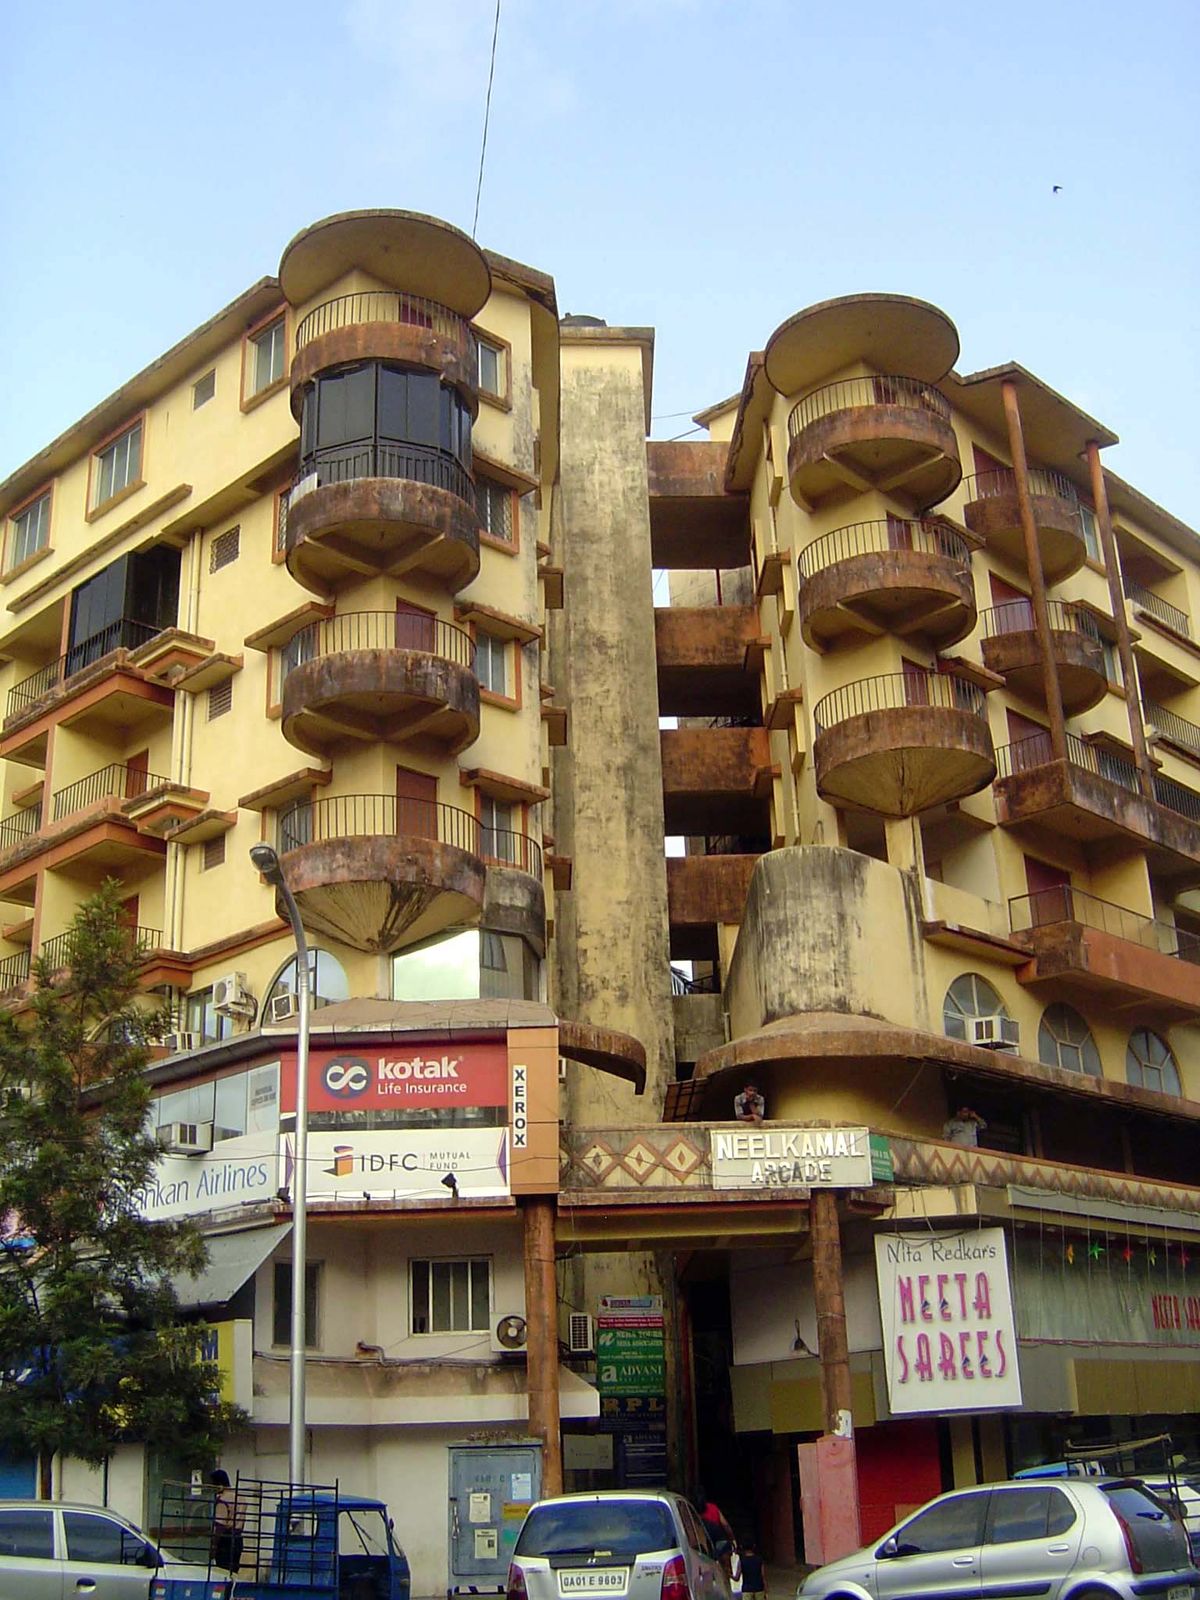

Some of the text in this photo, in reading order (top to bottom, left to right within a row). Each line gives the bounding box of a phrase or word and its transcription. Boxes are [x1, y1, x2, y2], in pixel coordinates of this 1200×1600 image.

[378, 1056, 458, 1079] kotak
[377, 1082, 467, 1095] Life Insurance
[514, 1069, 526, 1146] XEROX
[429, 1152, 471, 1160] MUTUAL
[717, 1131, 865, 1160] NEELKAMAL
[360, 1153, 418, 1172] IDFC
[429, 1162, 458, 1170] FUND
[751, 1160, 832, 1183] ARCADE
[134, 1163, 267, 1211] ankan Airlines
[887, 1238, 997, 1264] Nita Redkar's
[897, 1271, 993, 1323] NEETA
[897, 1330, 1007, 1384] SAREES
[620, 1365, 662, 1376] ADVANI
